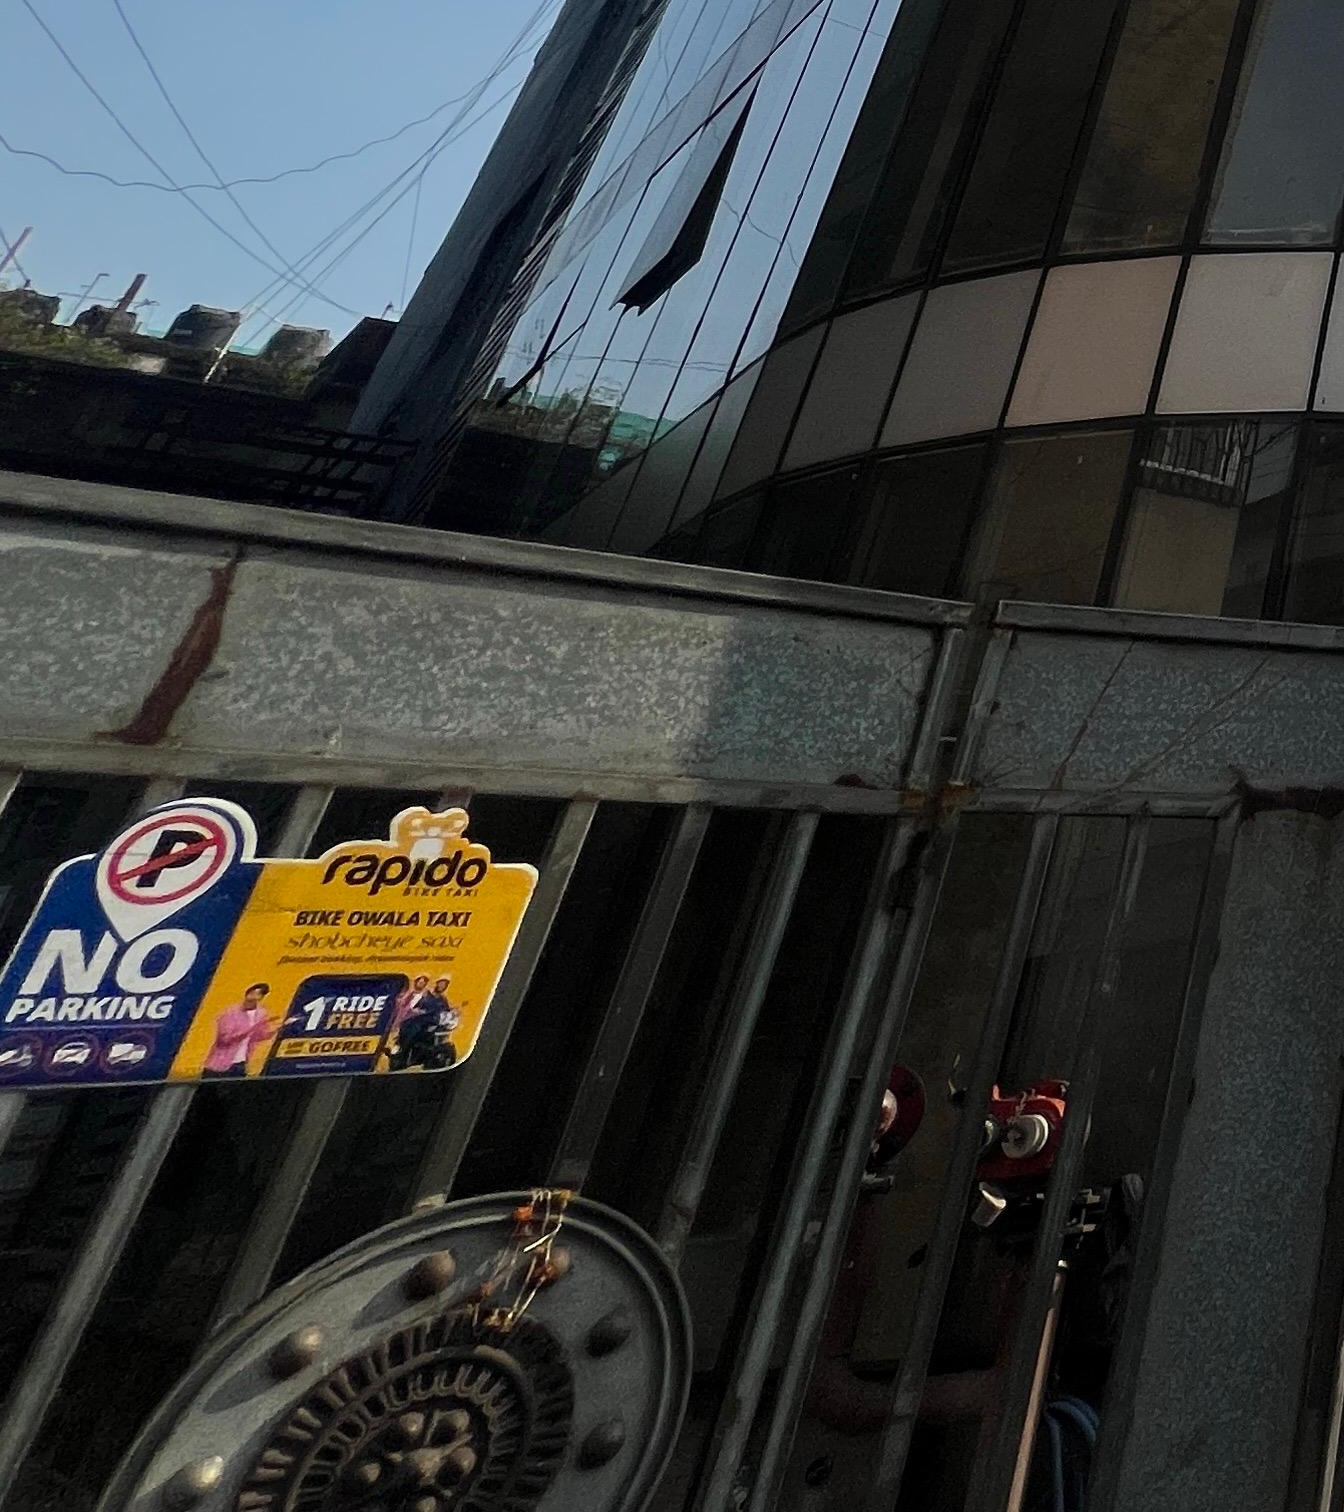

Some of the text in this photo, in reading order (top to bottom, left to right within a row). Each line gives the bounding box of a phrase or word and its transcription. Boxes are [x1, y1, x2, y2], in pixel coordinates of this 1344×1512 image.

[320, 850, 488, 896] rapido
[444, 888, 479, 897] TAXI
[293, 910, 473, 928] BIKE OWALA TAXI
[19, 928, 200, 995] NO
[4, 996, 176, 1024] PARKING
[303, 994, 390, 1032] 1 RIDE
[323, 1011, 381, 1030] FREE
[308, 1039, 371, 1054] GOFREE
